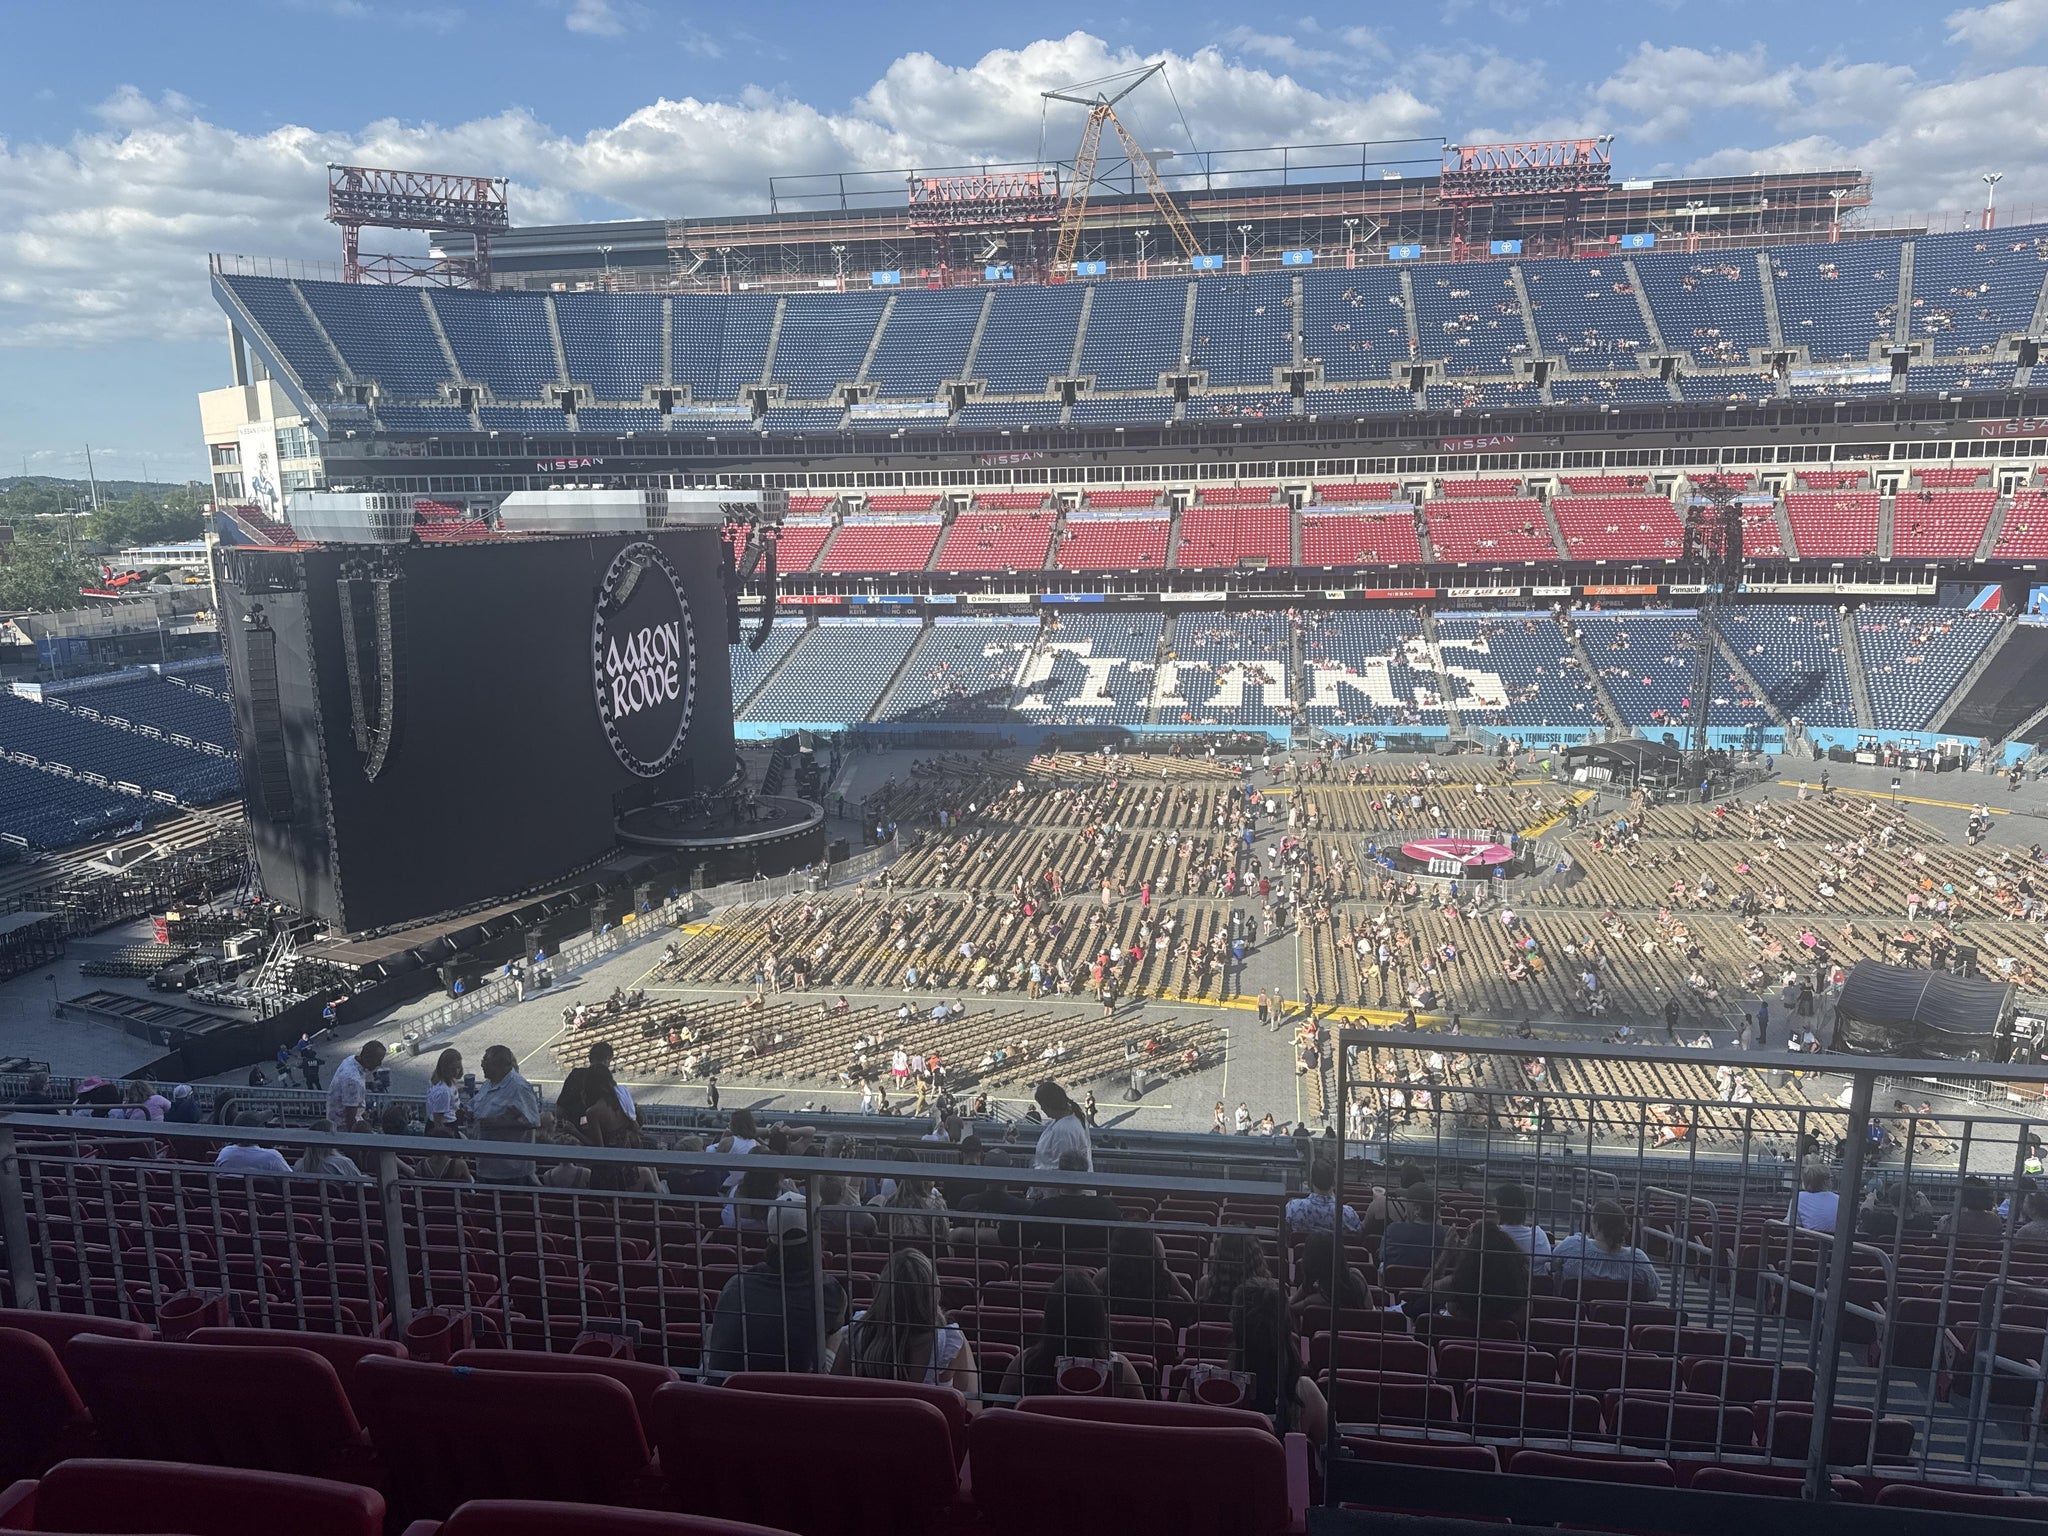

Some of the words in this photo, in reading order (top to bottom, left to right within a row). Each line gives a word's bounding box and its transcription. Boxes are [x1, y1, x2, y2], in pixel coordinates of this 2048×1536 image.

[1443, 436, 1514, 452] NISSAN
[537, 458, 604, 472] NISSAN
[982, 452, 1043, 466] NISSAN
[606, 621, 681, 678] AARON
[984, 638, 1509, 711] TITANS
[611, 660, 680, 720] ROWE
[1525, 732, 1562, 743] TENNESSEE
[1762, 735, 1784, 744] TOUGH
